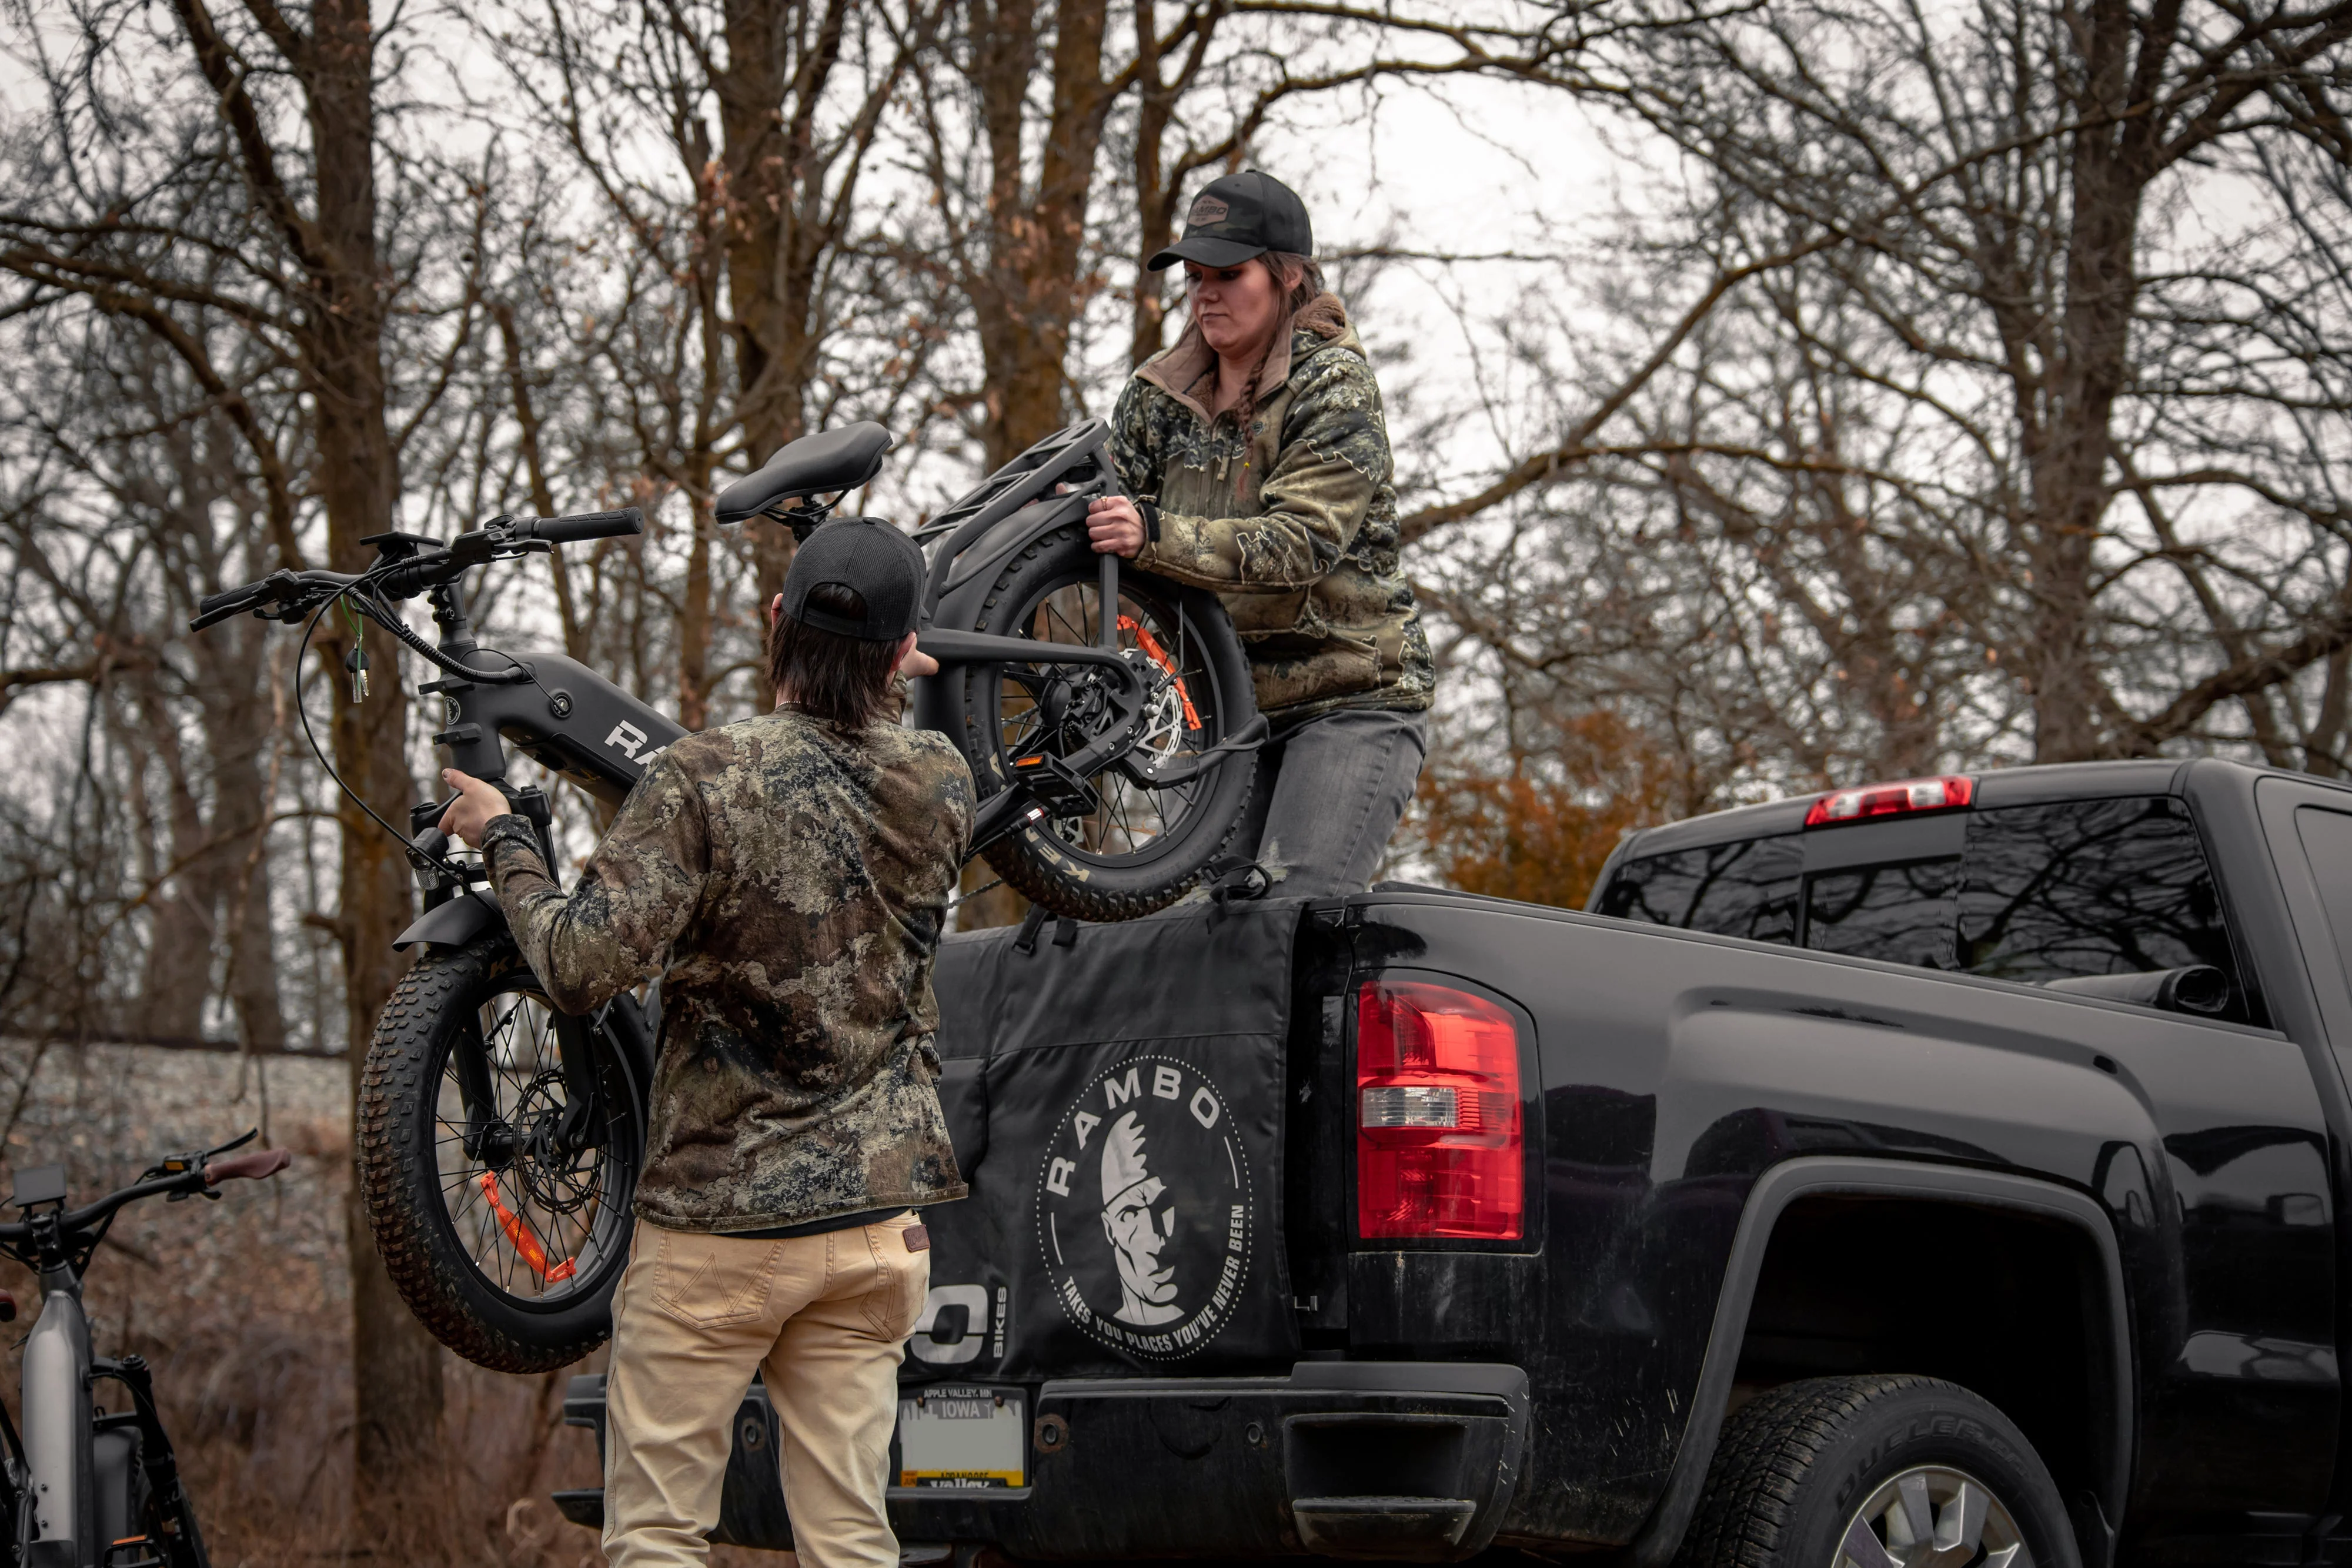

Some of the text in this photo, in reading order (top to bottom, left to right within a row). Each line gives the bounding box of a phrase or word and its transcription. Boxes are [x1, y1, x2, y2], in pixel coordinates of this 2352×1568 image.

[1047, 1065, 1220, 1196] RAMBO
[1061, 1205, 1244, 1352] TAKES YOU PLACES YOU'VE NEVER BEEN
[993, 1286, 1007, 1358] BIKES
[924, 1389, 947, 1398] APPLE
[980, 1389, 992, 1398] MN
[942, 1401, 980, 1418] IOWA
